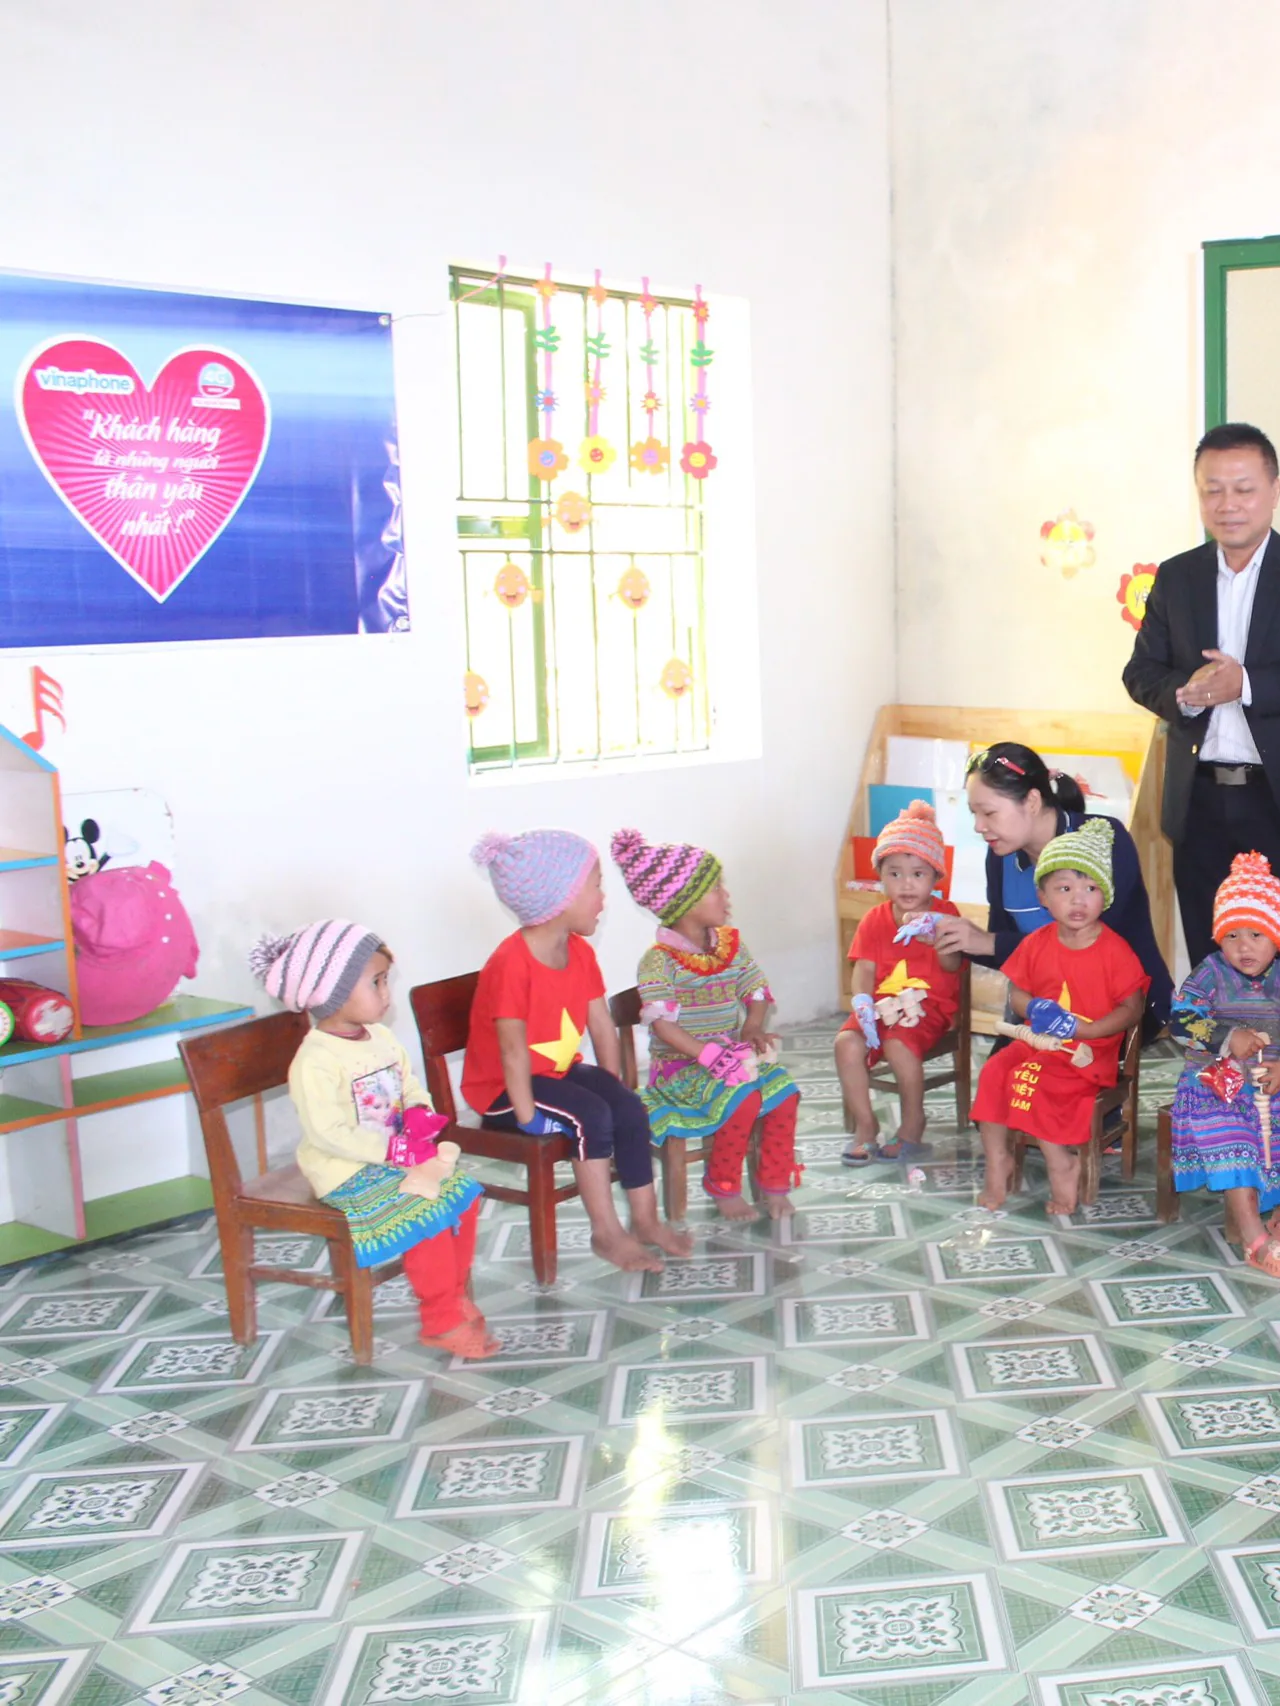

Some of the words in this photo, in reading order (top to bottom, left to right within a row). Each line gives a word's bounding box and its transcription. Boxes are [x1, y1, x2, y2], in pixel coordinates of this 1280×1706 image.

[40, 368, 130, 391] vinaphone
[167, 417, 222, 452] hàng
[104, 472, 157, 500] thân
[160, 476, 205, 508] yêu
